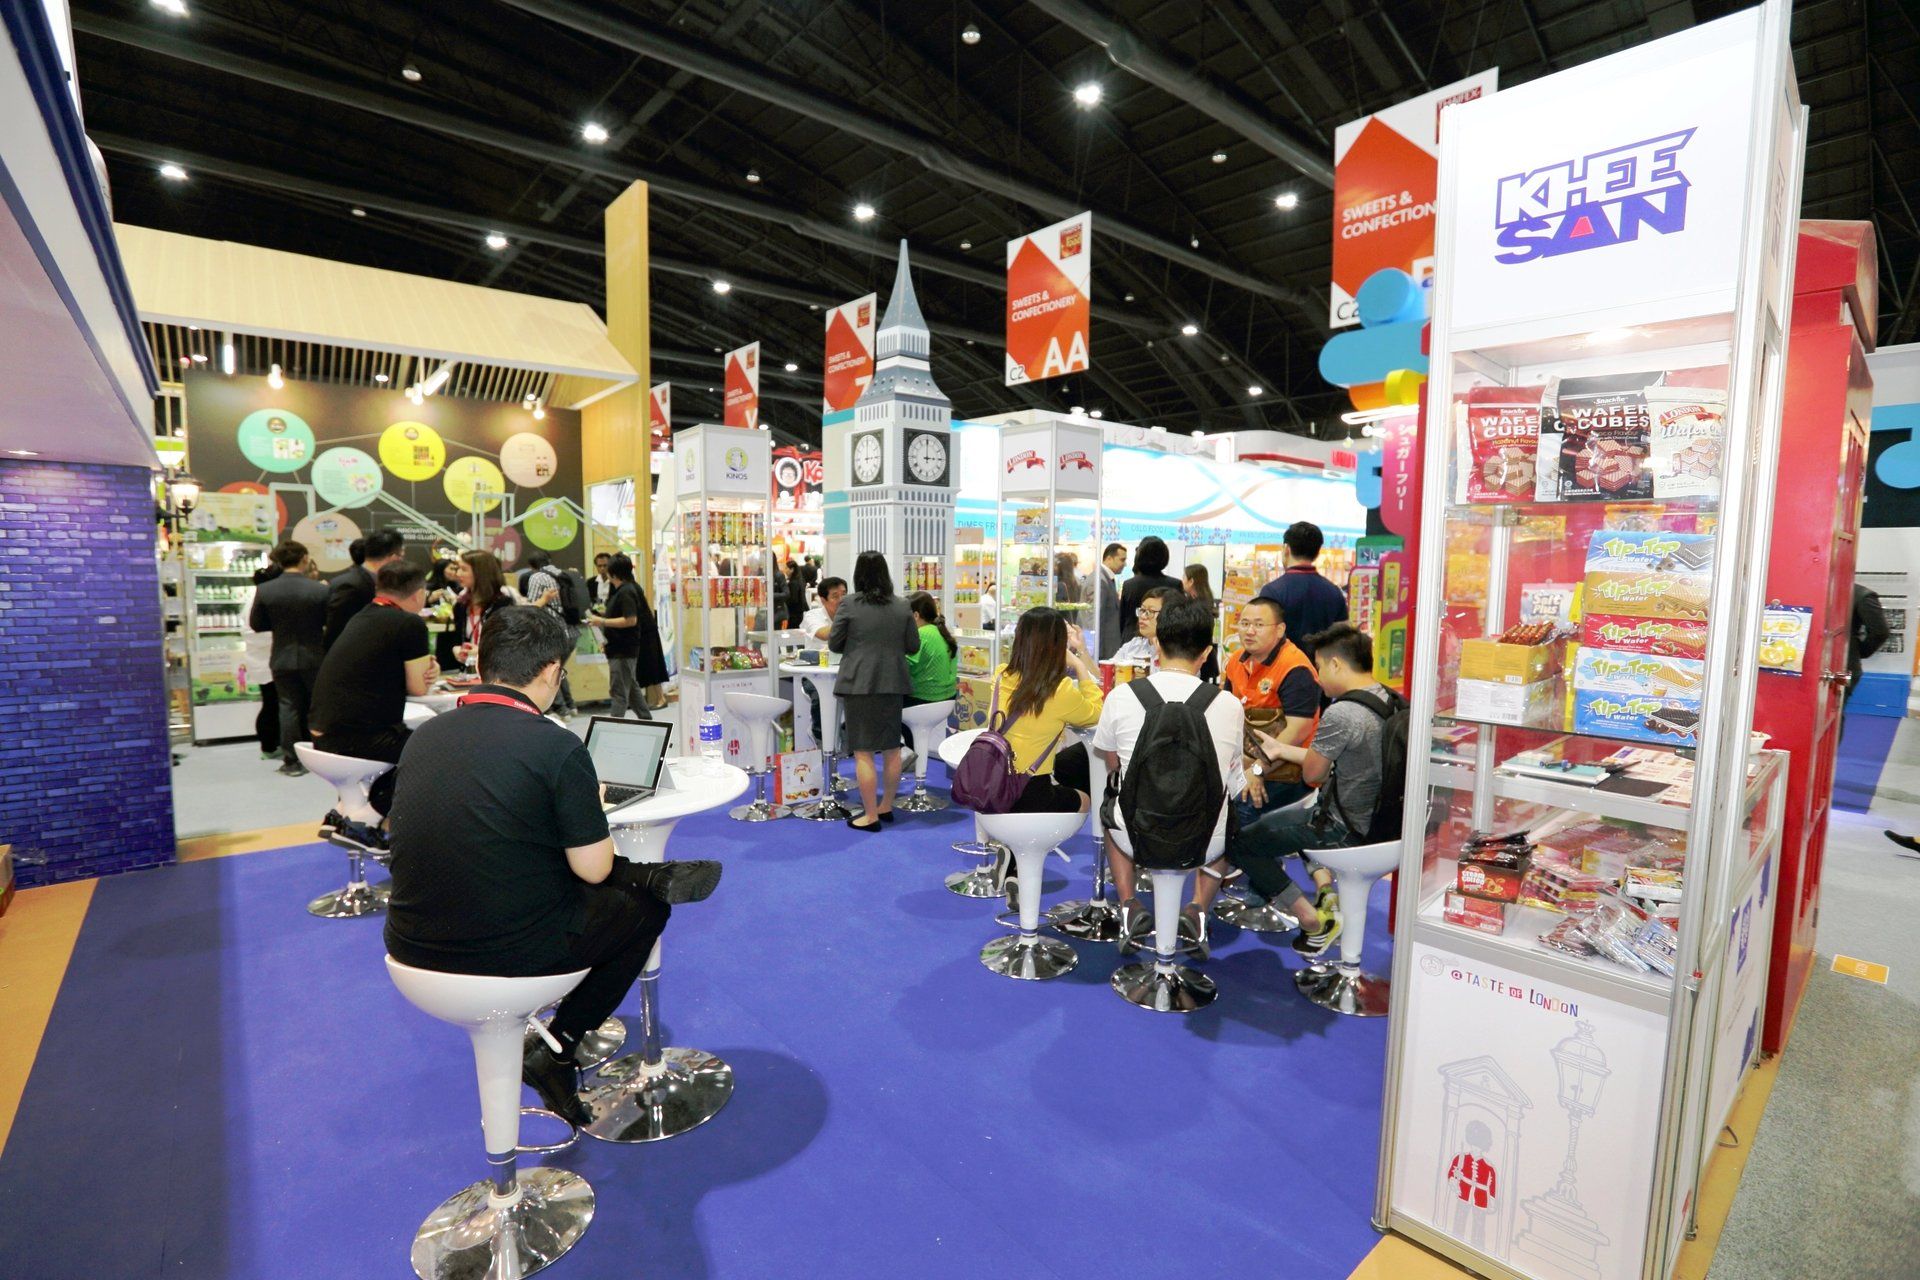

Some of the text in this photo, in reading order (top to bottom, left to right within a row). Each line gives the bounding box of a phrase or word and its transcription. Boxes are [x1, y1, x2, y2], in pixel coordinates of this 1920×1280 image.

[1495, 127, 1698, 229] KHEE
[1342, 190, 1413, 223] SWEETS &
[1494, 187, 1688, 264] SAN
[1011, 294, 1076, 322] CONFECTIONERY
[1012, 290, 1049, 311] SWEETS &
[1041, 330, 1089, 378] AA
[1009, 365, 1025, 381] C2
[1572, 404, 1648, 418] WAFER
[1661, 406, 1700, 419] LONDON
[1578, 416, 1650, 430] CUBES
[726, 473, 748, 481] KINOS
[1604, 537, 1680, 560] Tip-Top
[1598, 577, 1672, 601] Tip-Top
[1599, 620, 1672, 643] Tip-Top
[1591, 658, 1662, 678] Tip-Top
[1590, 697, 1662, 718] Tip-Top
[1466, 971, 1504, 994] TASTE
[1510, 987, 1522, 999] OF
[1530, 989, 1578, 1017] LONDON
